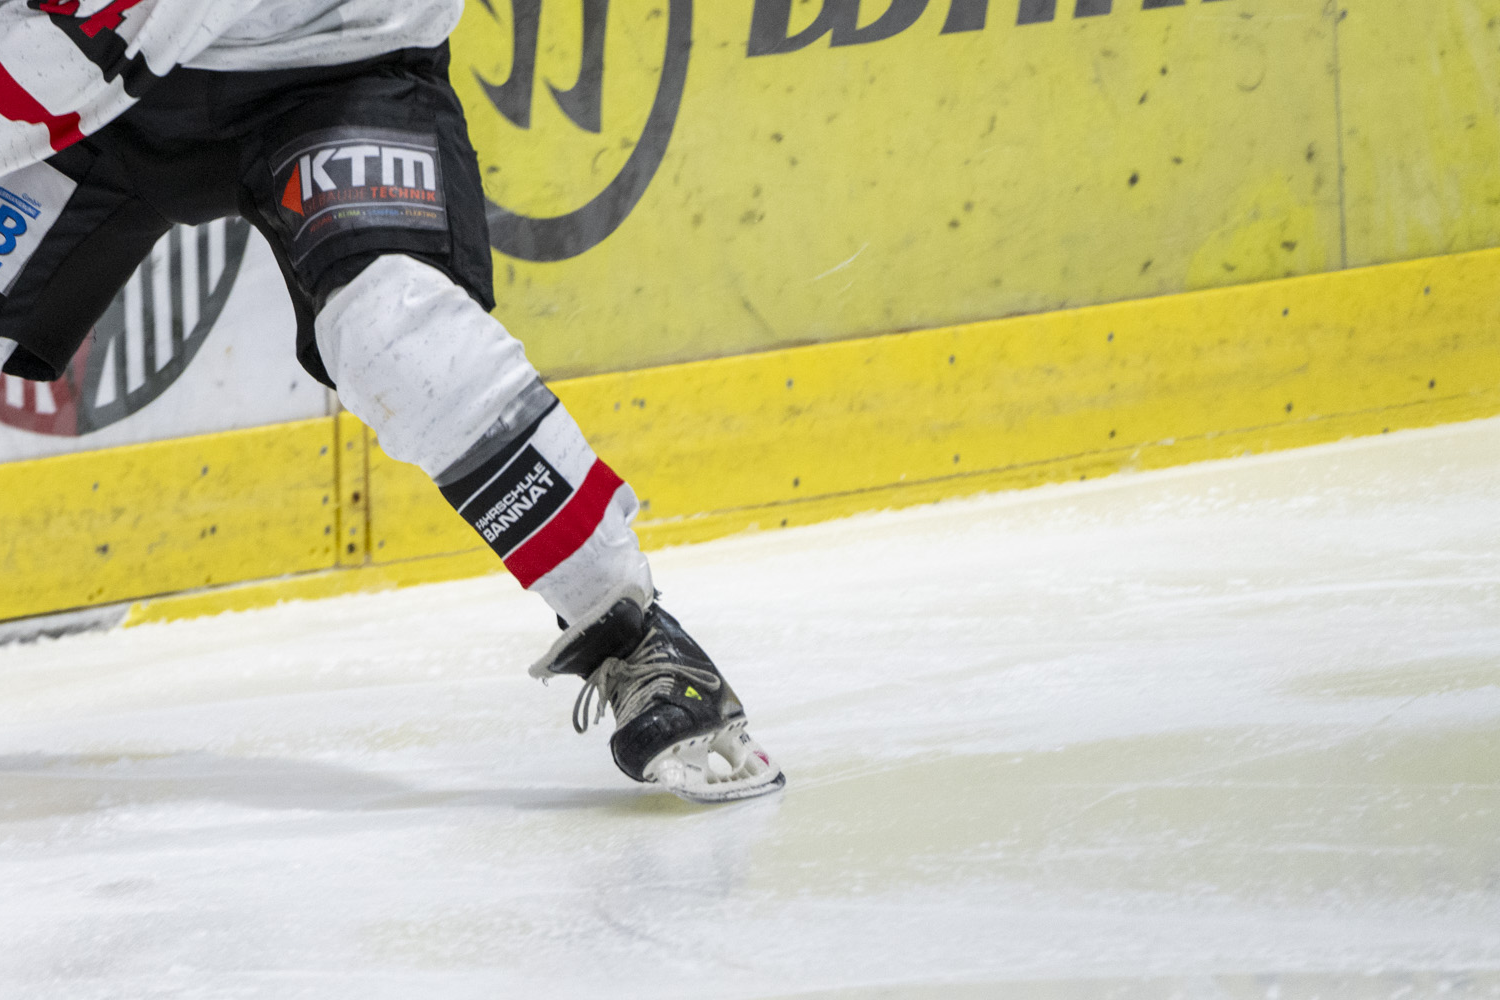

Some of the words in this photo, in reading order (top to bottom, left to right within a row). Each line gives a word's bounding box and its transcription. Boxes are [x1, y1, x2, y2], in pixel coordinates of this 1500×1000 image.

[299, 145, 436, 202] KTM
[475, 462, 546, 530] FAHRSCHULE
[483, 470, 554, 543] BANNAT
